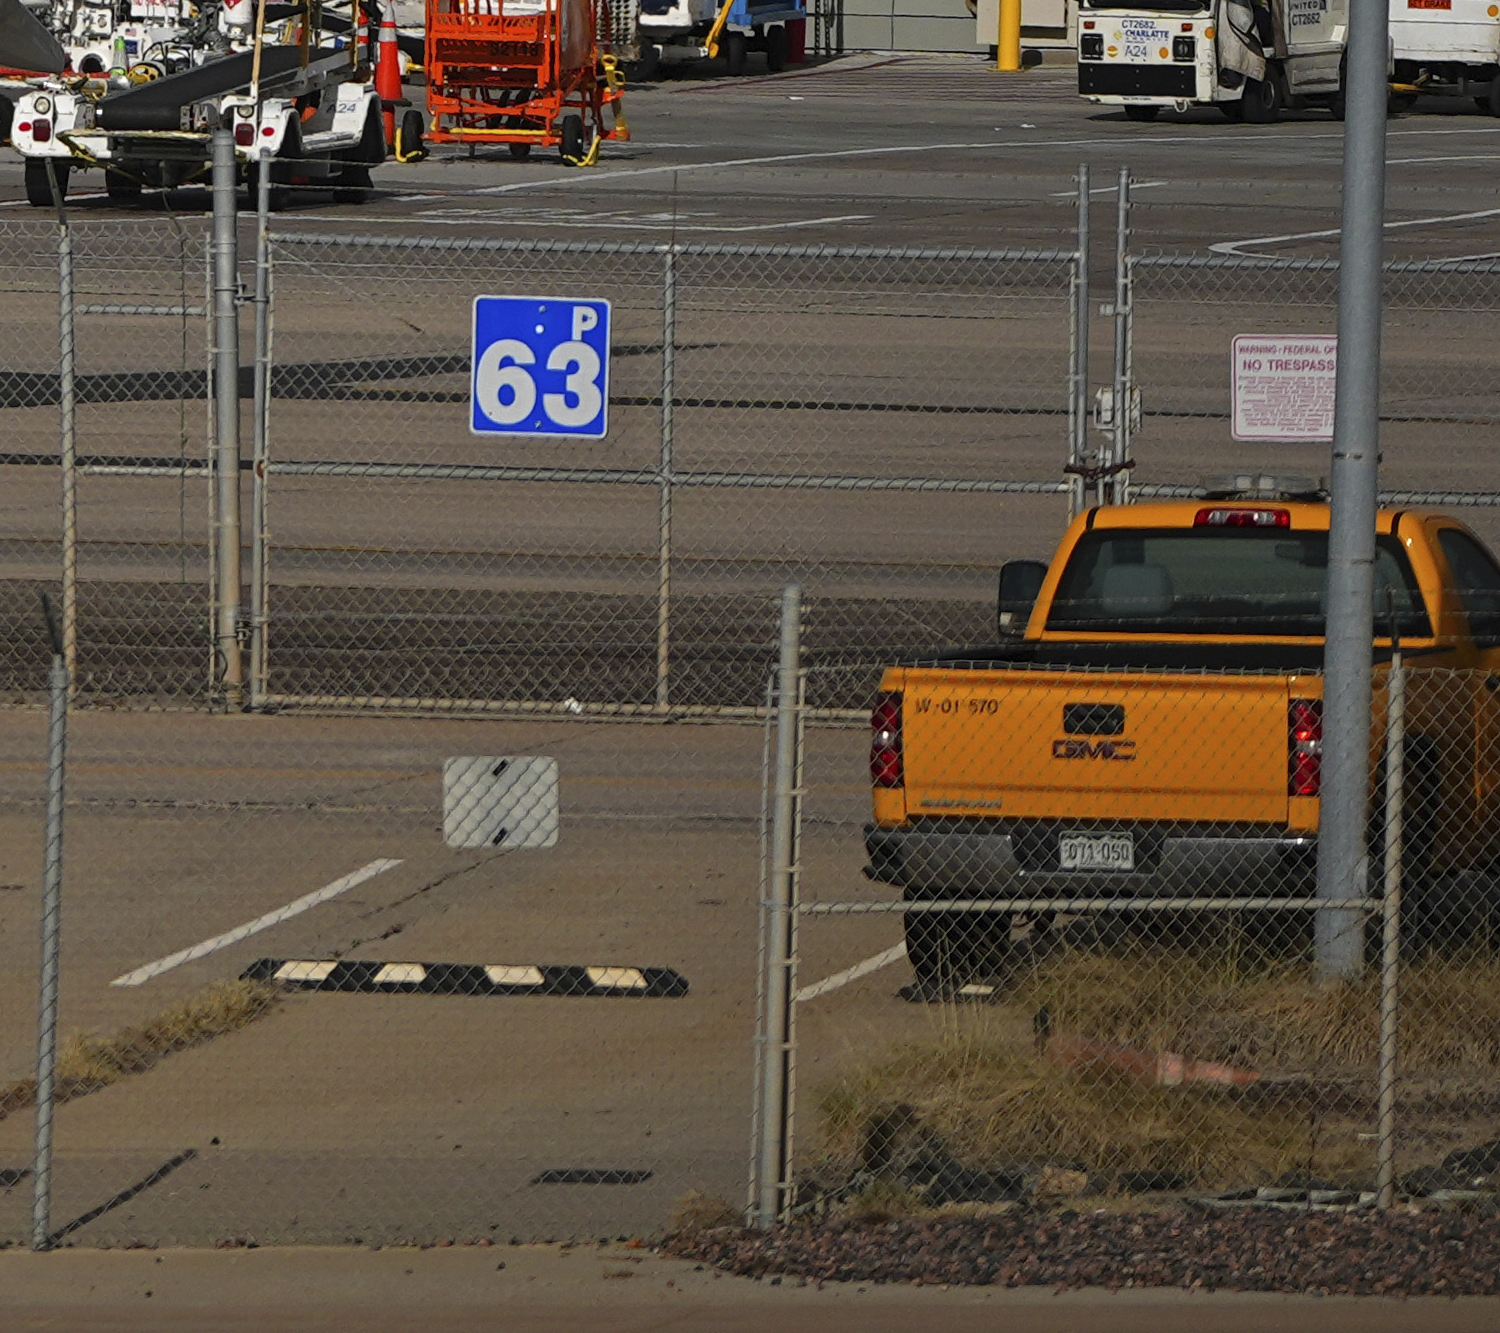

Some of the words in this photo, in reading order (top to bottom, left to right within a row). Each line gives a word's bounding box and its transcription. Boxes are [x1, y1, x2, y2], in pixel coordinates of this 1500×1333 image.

[1125, 30, 1169, 38] CHARLATTE
[1125, 45, 1147, 57] A24
[572, 306, 598, 341] P
[1283, 344, 1322, 354] FEDERAL
[1243, 359, 1262, 371] NO
[476, 338, 602, 427] 63
[1052, 740, 1136, 760] GMC
